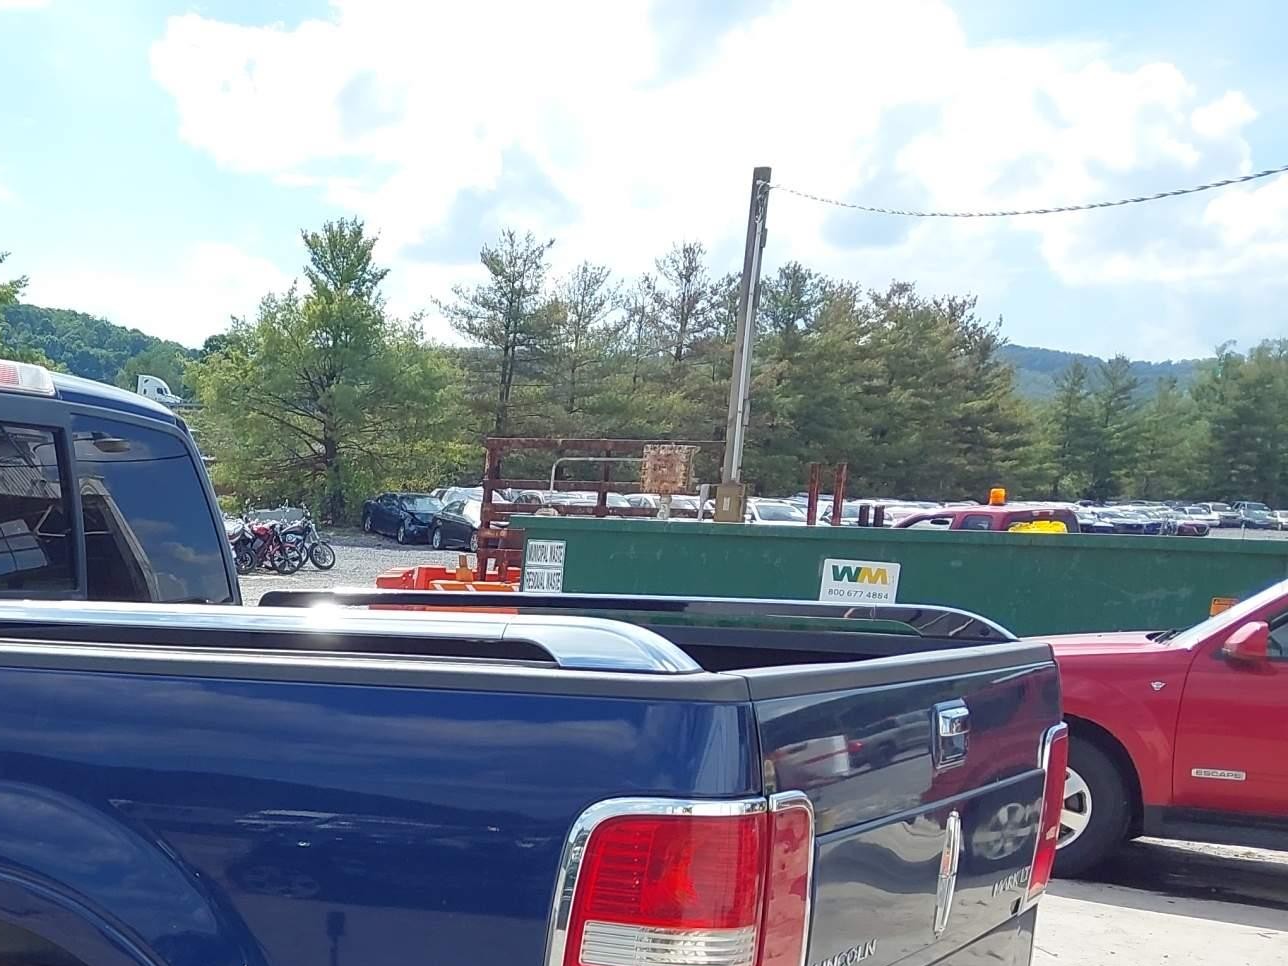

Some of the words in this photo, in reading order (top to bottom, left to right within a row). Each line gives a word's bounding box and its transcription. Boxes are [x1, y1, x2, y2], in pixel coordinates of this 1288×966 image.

[527, 544, 549, 562] MUNICIPAL
[550, 544, 563, 563] WASTE
[526, 571, 545, 590] RESIDUAL
[546, 571, 561, 590] WASTE
[832, 565, 888, 585] WM
[828, 588, 845, 597] 800
[847, 590, 864, 598] 677
[1195, 770, 1242, 779] ESCAPE
[992, 870, 1020, 897] MARK
[1019, 864, 1031, 883] LT
